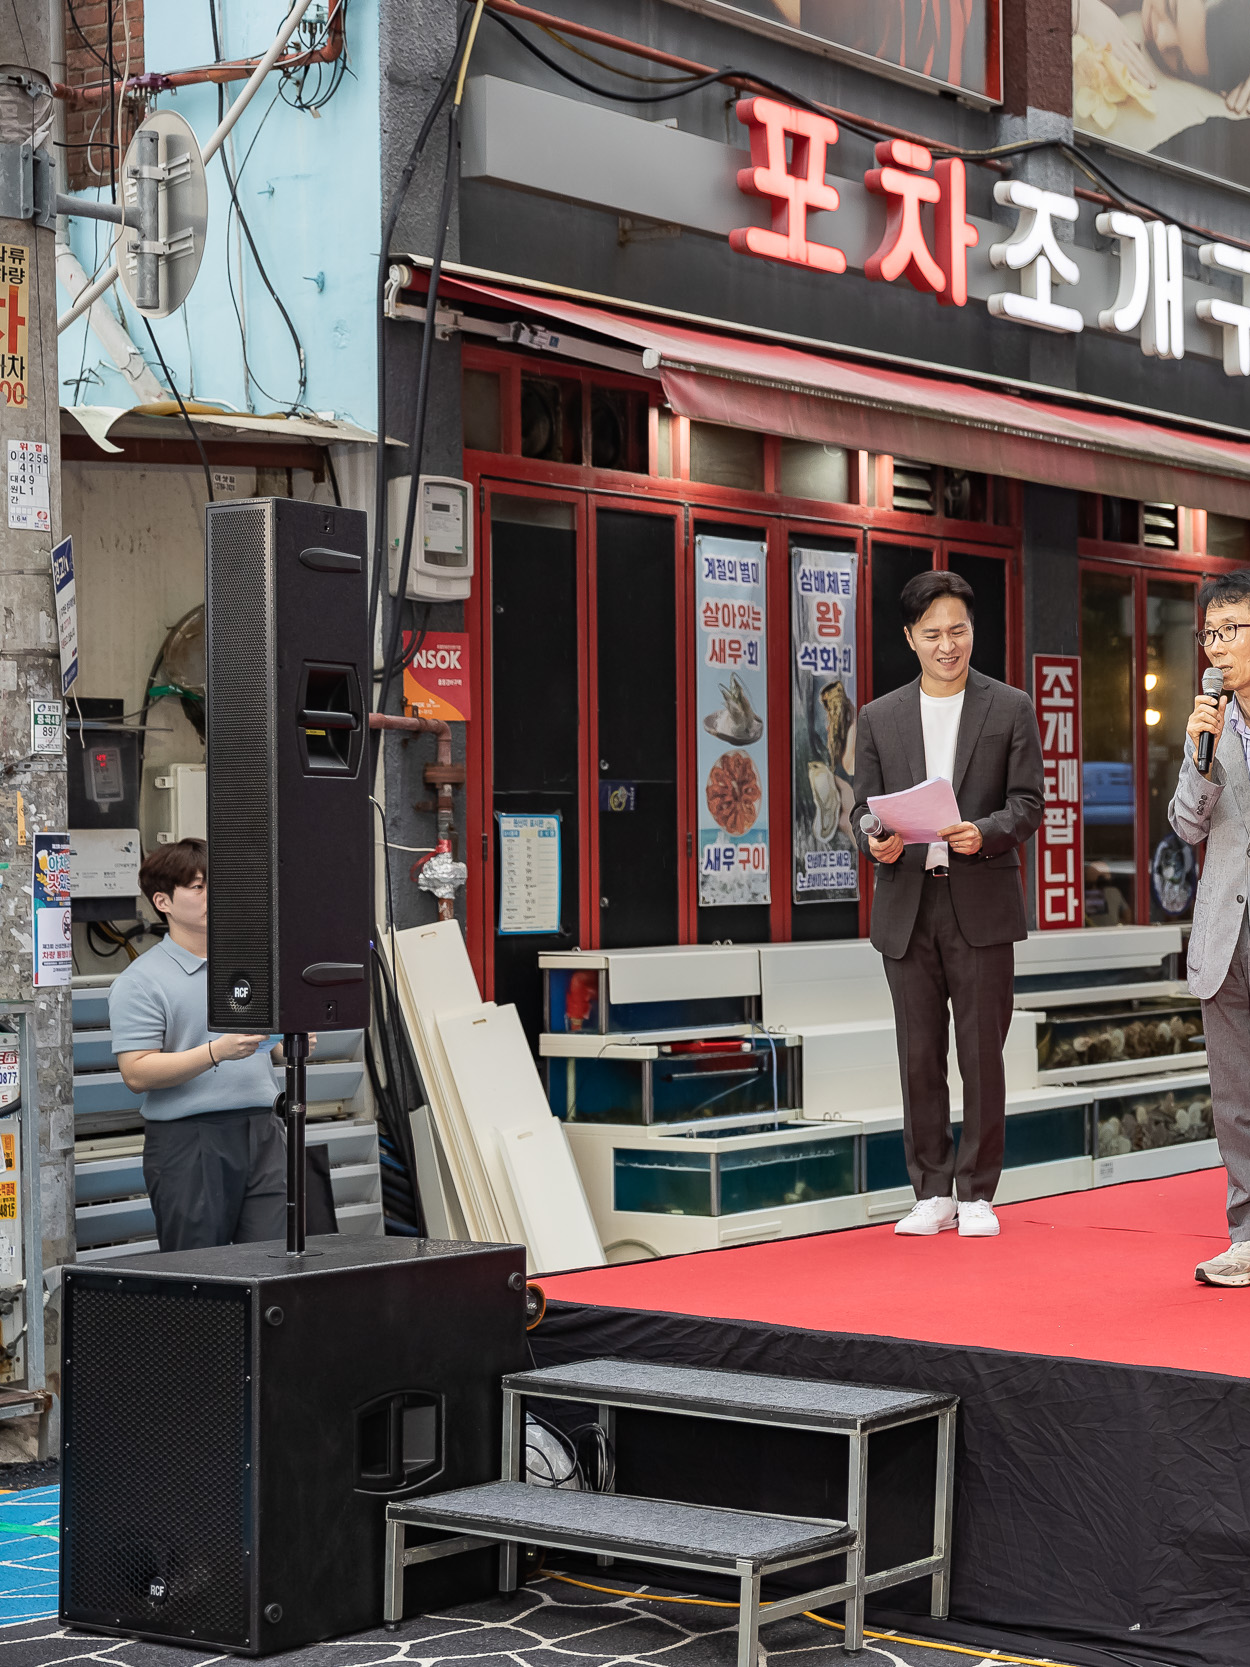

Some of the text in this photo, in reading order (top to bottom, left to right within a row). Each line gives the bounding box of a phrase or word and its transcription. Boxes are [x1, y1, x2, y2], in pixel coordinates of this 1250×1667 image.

[19, 464, 42, 474] 411
[704, 557, 760, 585] 계절의 별미
[800, 568, 850, 595] 삼배체굴
[702, 601, 762, 632] 살아있는
[816, 601, 843, 637] 왕
[413, 649, 462, 670] NSOK
[42, 726, 57, 737] 897
[704, 847, 765, 872] 새우 구이
[234, 987, 249, 998] RCF
[150, 1584, 165, 1597] RCF
